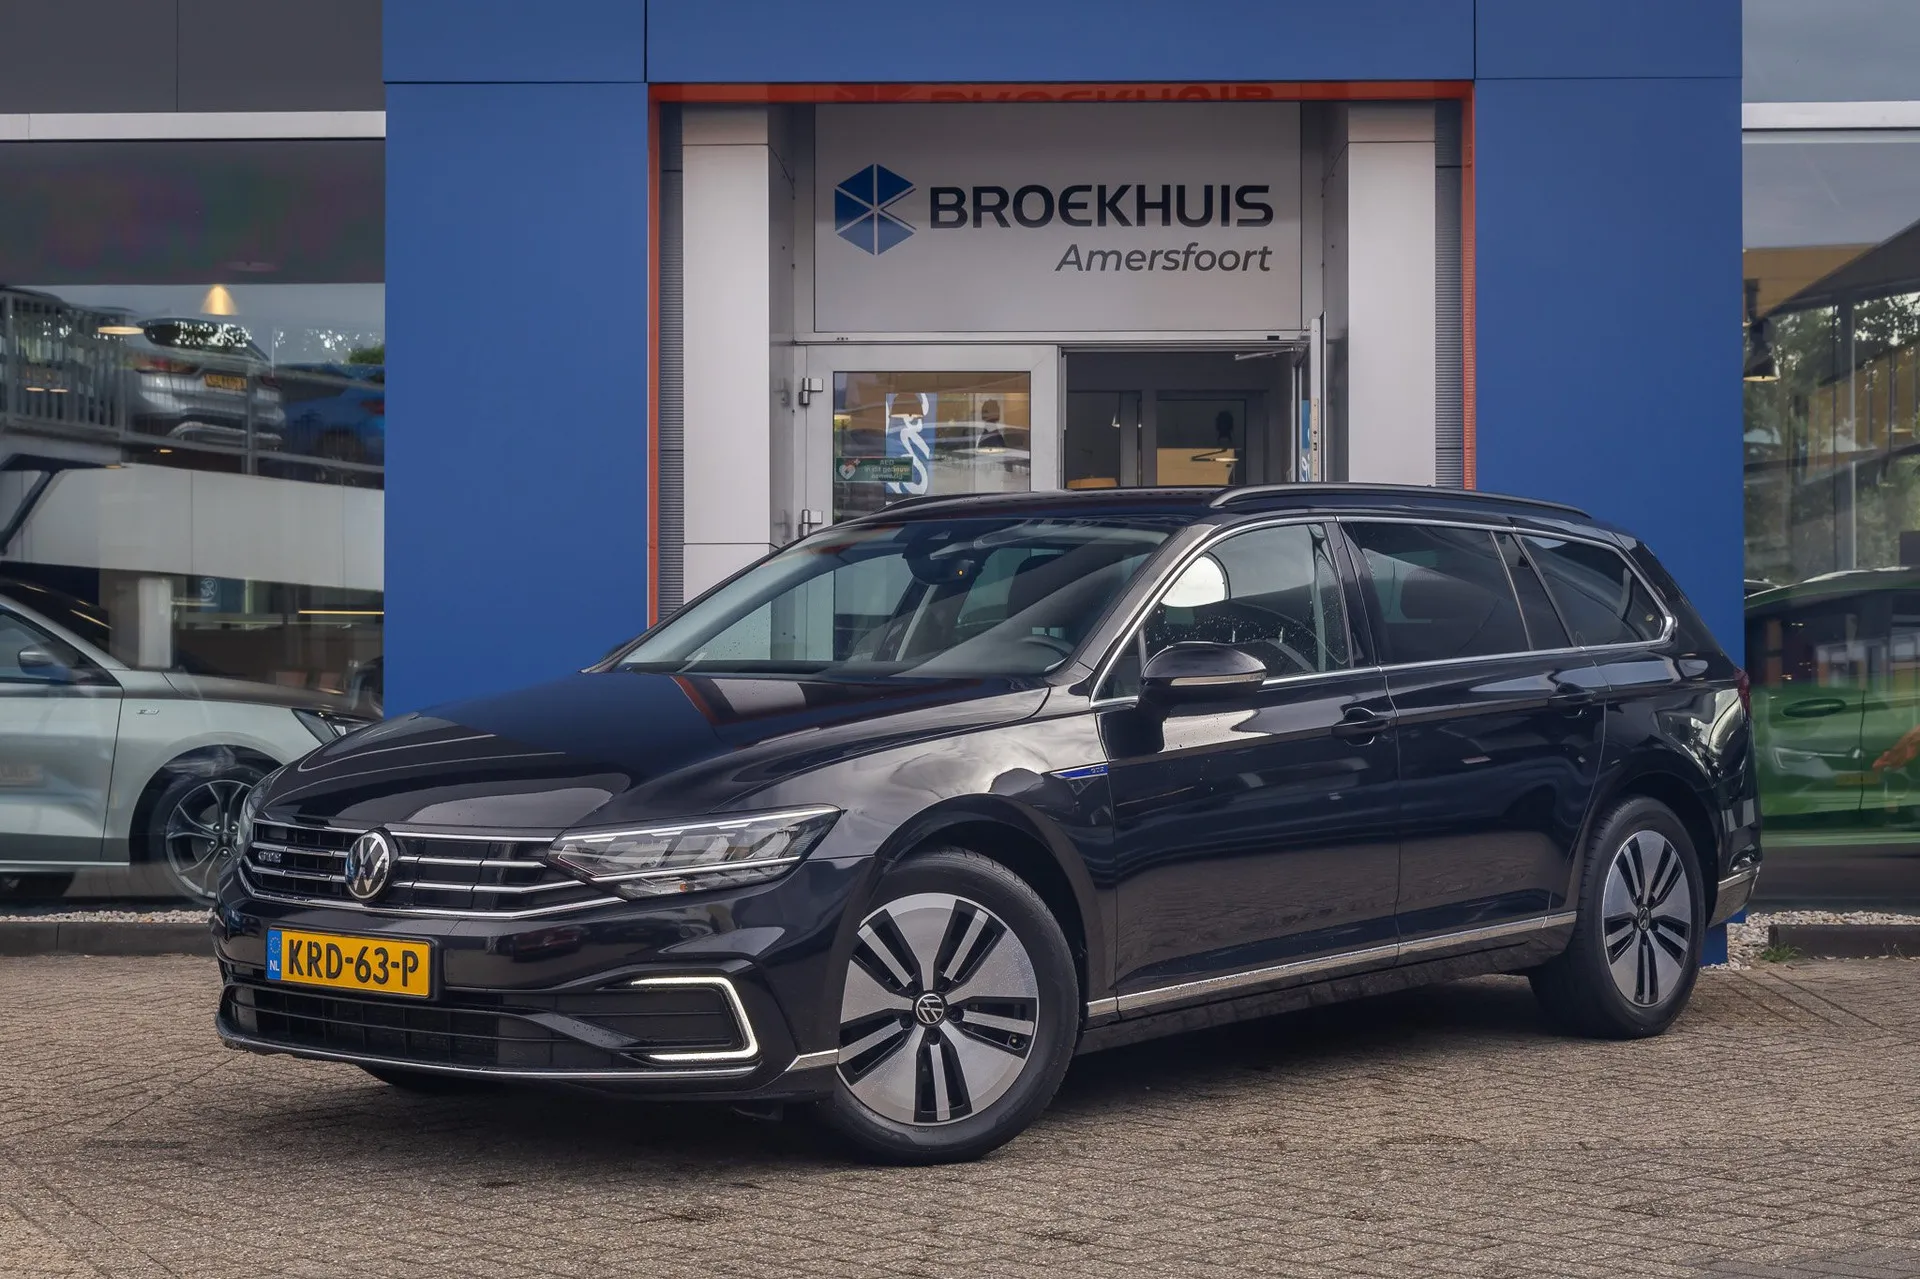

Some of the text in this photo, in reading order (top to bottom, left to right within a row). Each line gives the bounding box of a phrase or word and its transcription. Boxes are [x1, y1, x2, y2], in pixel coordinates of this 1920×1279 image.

[930, 184, 1274, 229] BROEKHUIS
[1055, 242, 1272, 272] Amersfoort
[269, 959, 280, 972] NL
[288, 939, 419, 987] KRD-63-P
